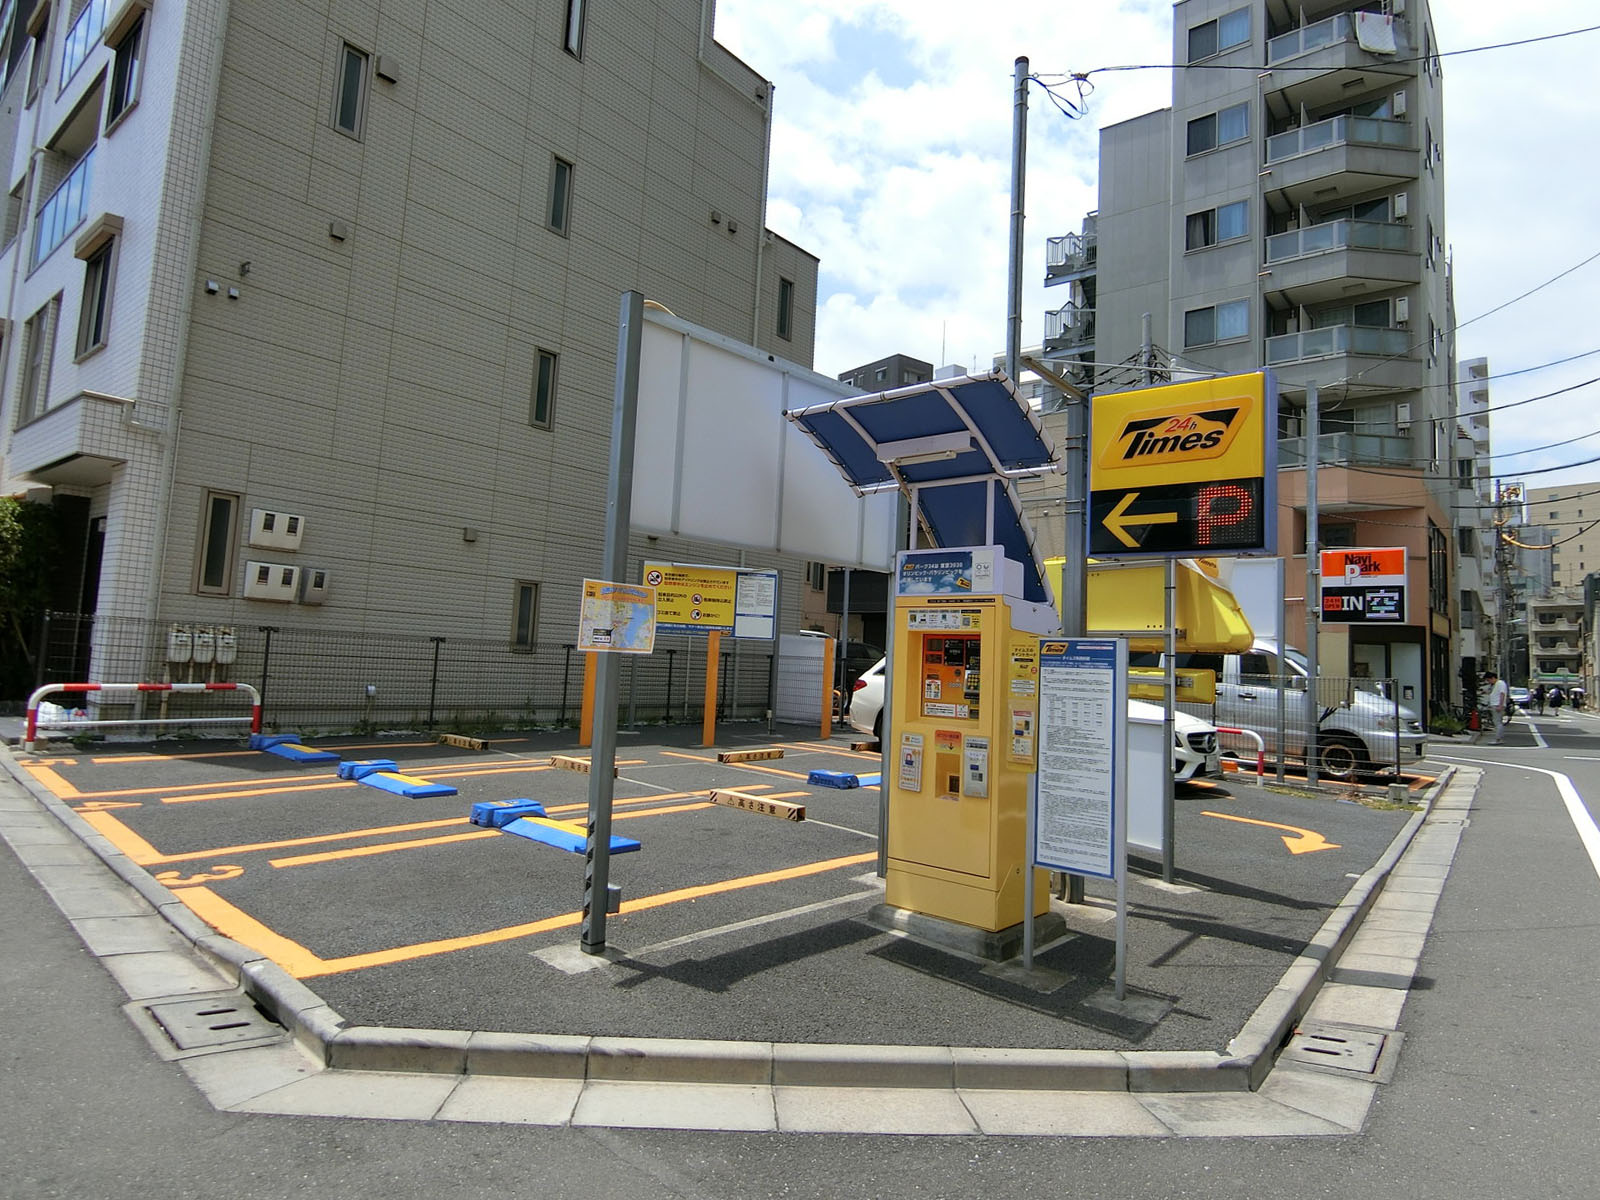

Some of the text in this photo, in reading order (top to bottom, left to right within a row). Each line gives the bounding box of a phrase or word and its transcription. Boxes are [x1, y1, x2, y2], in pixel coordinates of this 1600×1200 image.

[1164, 416, 1198, 434] 24h
[1119, 412, 1232, 460] Times
[1197, 485, 1254, 545] P
[1344, 553, 1372, 565] Navi
[1344, 562, 1381, 585] Park
[1341, 596, 1363, 611] IN
[1365, 589, 1400, 619] 空
[1046, 644, 1066, 653] Times
[737, 798, 777, 815] 高さ注意
[154, 864, 245, 887] 3
